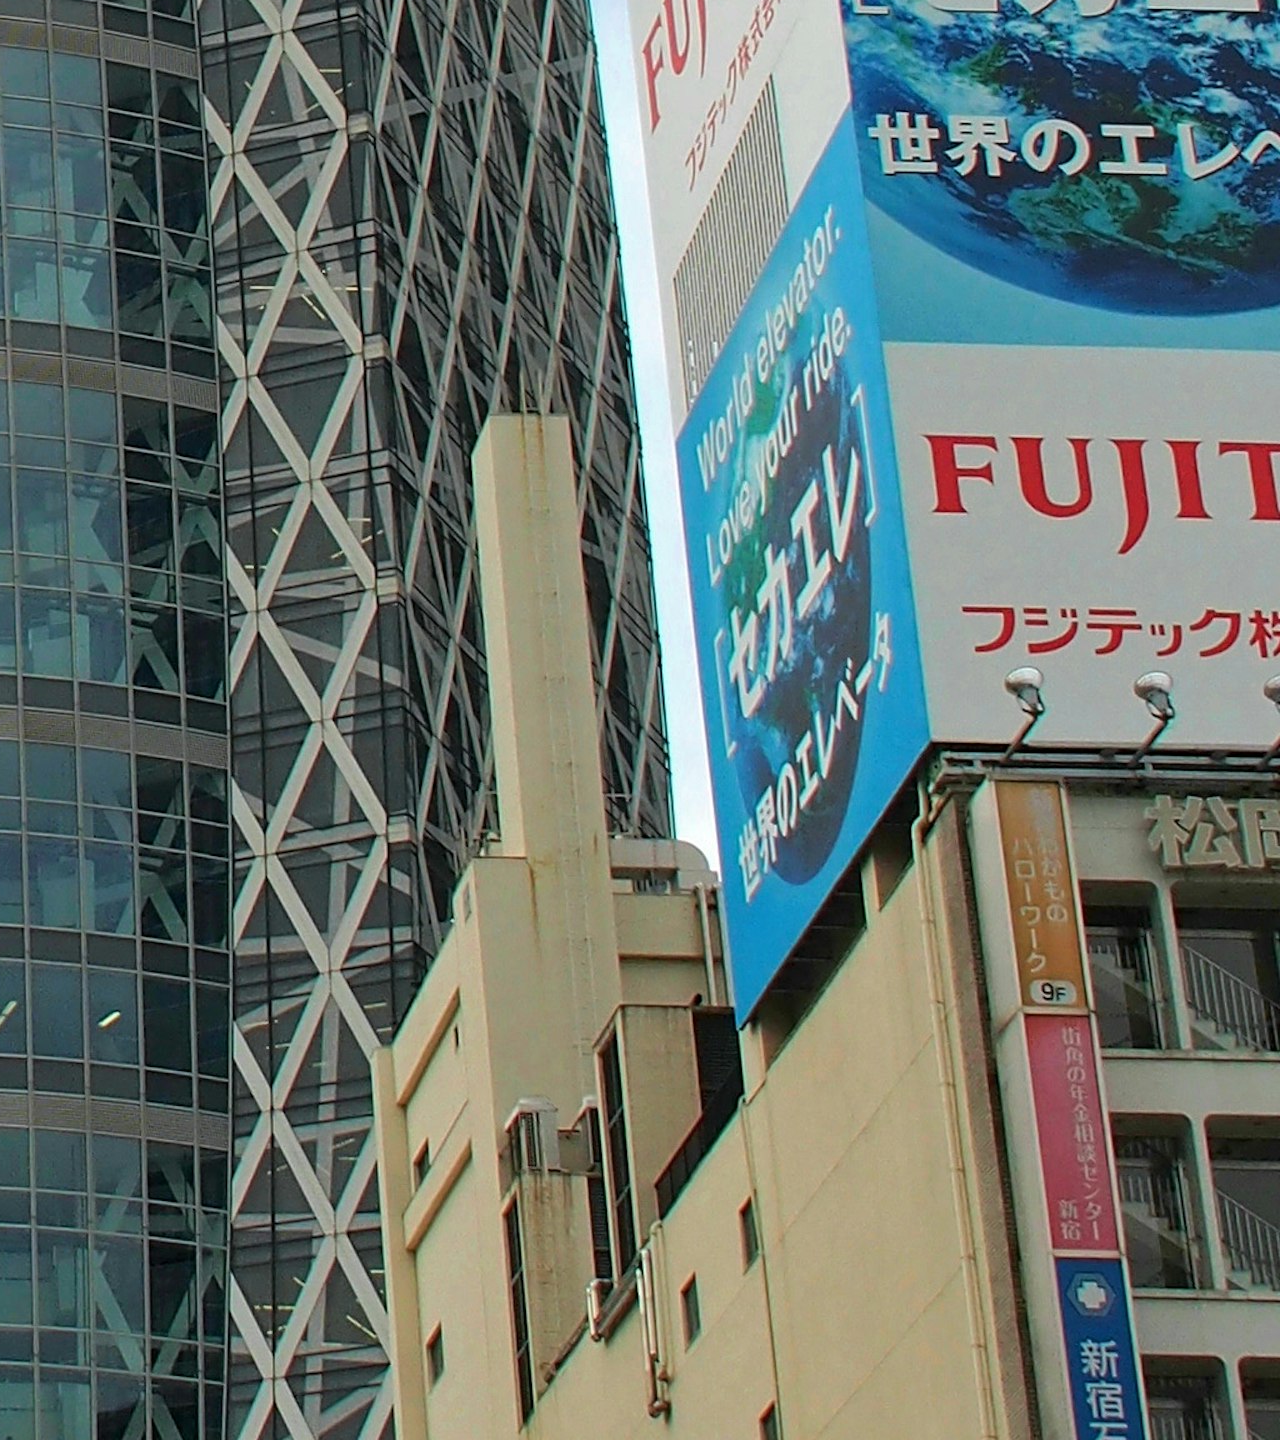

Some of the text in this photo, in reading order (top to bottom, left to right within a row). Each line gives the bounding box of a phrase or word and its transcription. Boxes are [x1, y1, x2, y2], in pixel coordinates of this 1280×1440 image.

[696, 203, 841, 492] World elevator.
[706, 306, 851, 587] Love your ride.
[1013, 838, 1047, 973] ハローワーク
[1041, 982, 1068, 1002] 9F
[1058, 1199, 1082, 1241] 新宿
[1061, 1027, 1102, 1241] 街角の年金相談センター
